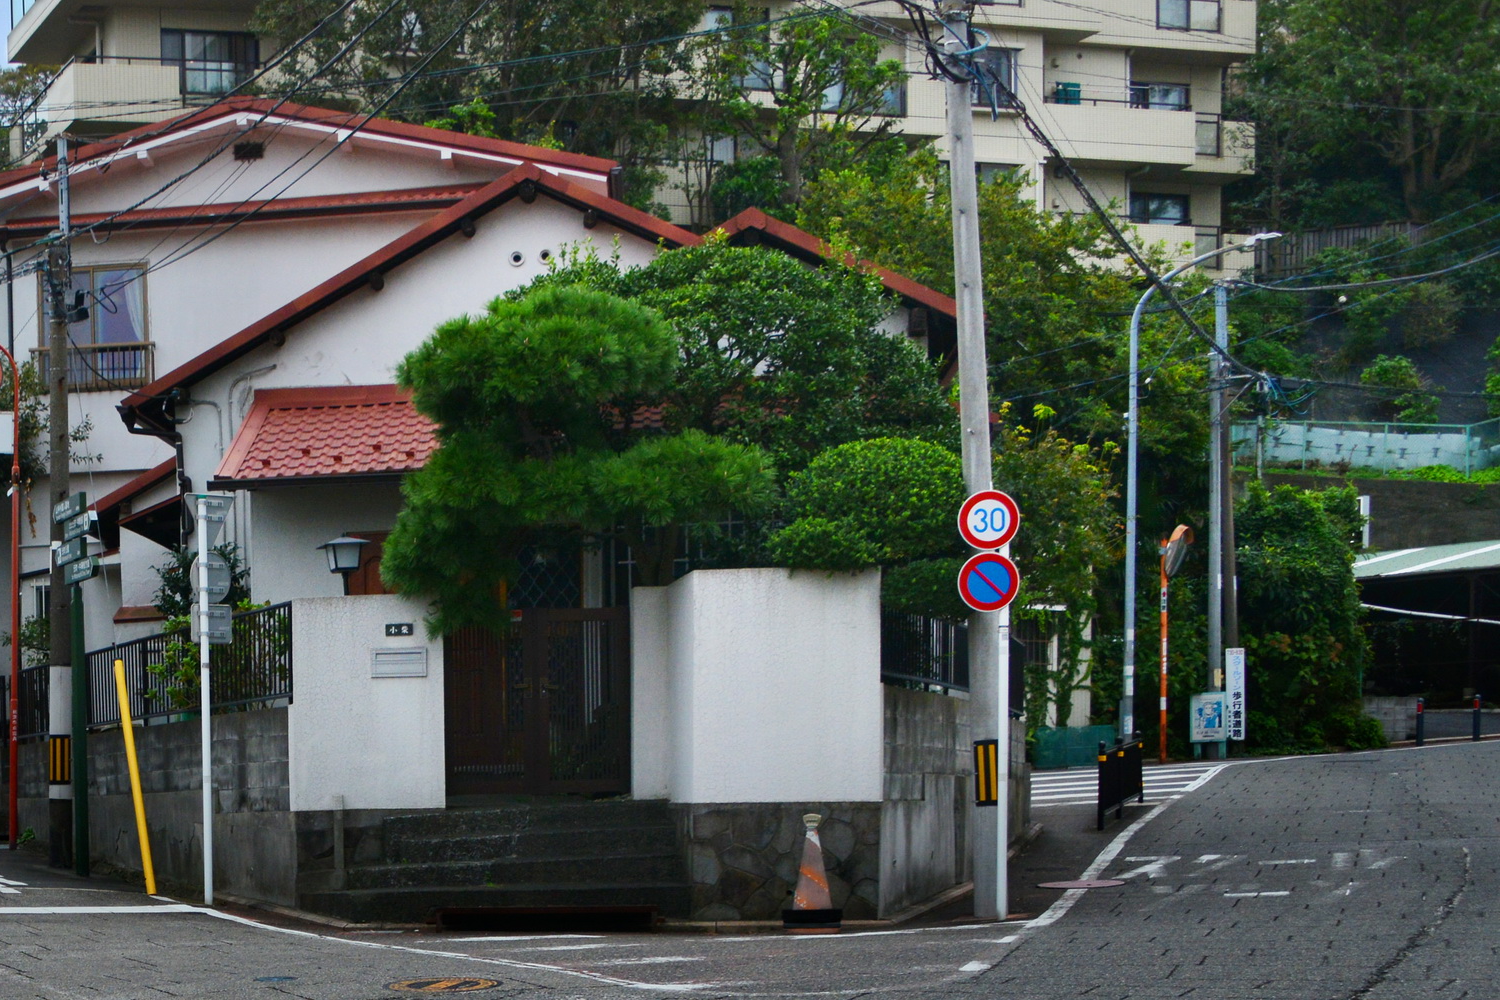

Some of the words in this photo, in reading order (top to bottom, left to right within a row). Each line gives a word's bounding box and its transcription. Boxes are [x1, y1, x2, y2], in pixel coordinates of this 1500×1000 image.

[973, 507, 1006, 533] 30
[1232, 691, 1242, 738] 歩行者道路
